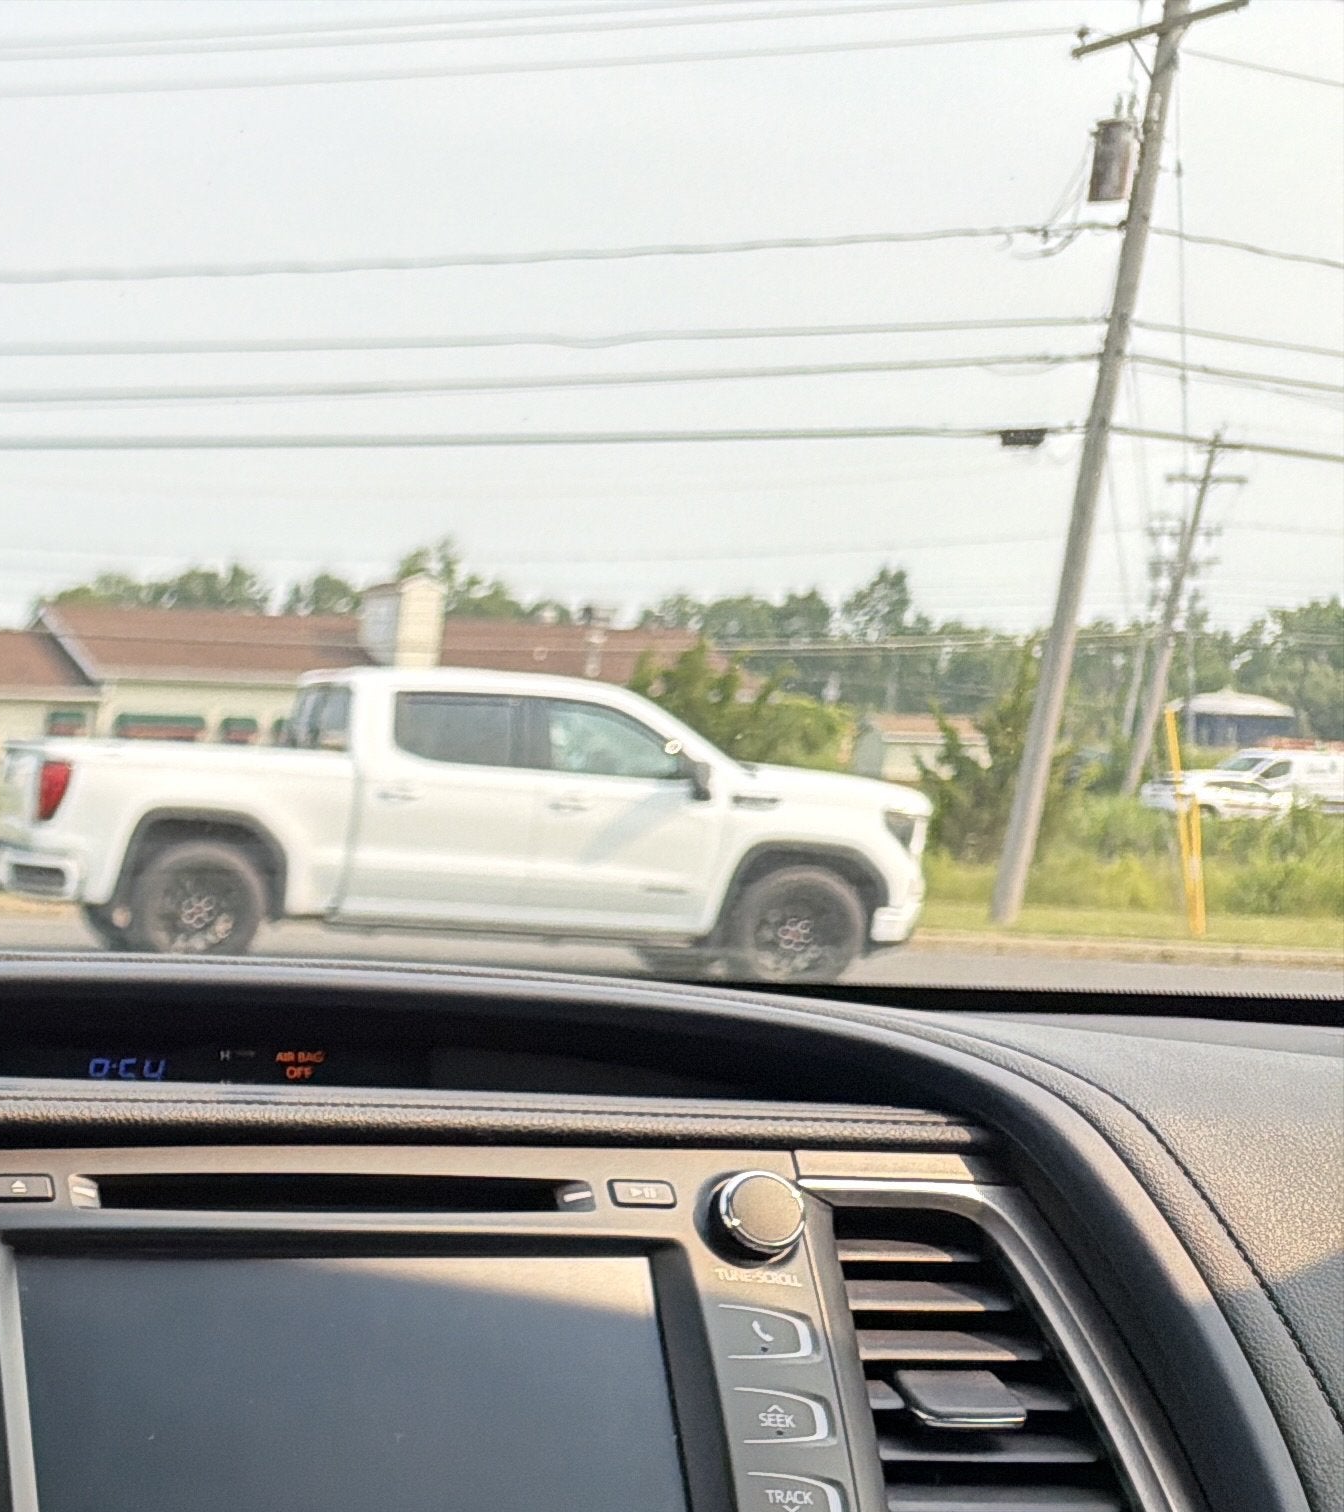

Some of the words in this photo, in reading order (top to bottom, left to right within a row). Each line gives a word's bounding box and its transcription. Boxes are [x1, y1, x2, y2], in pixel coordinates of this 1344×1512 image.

[276, 1051, 295, 1062] AIR
[297, 1051, 327, 1062] BAG
[286, 1066, 314, 1079] OFF
[759, 1413, 796, 1428] SEEK
[765, 1488, 813, 1505] TRACK
